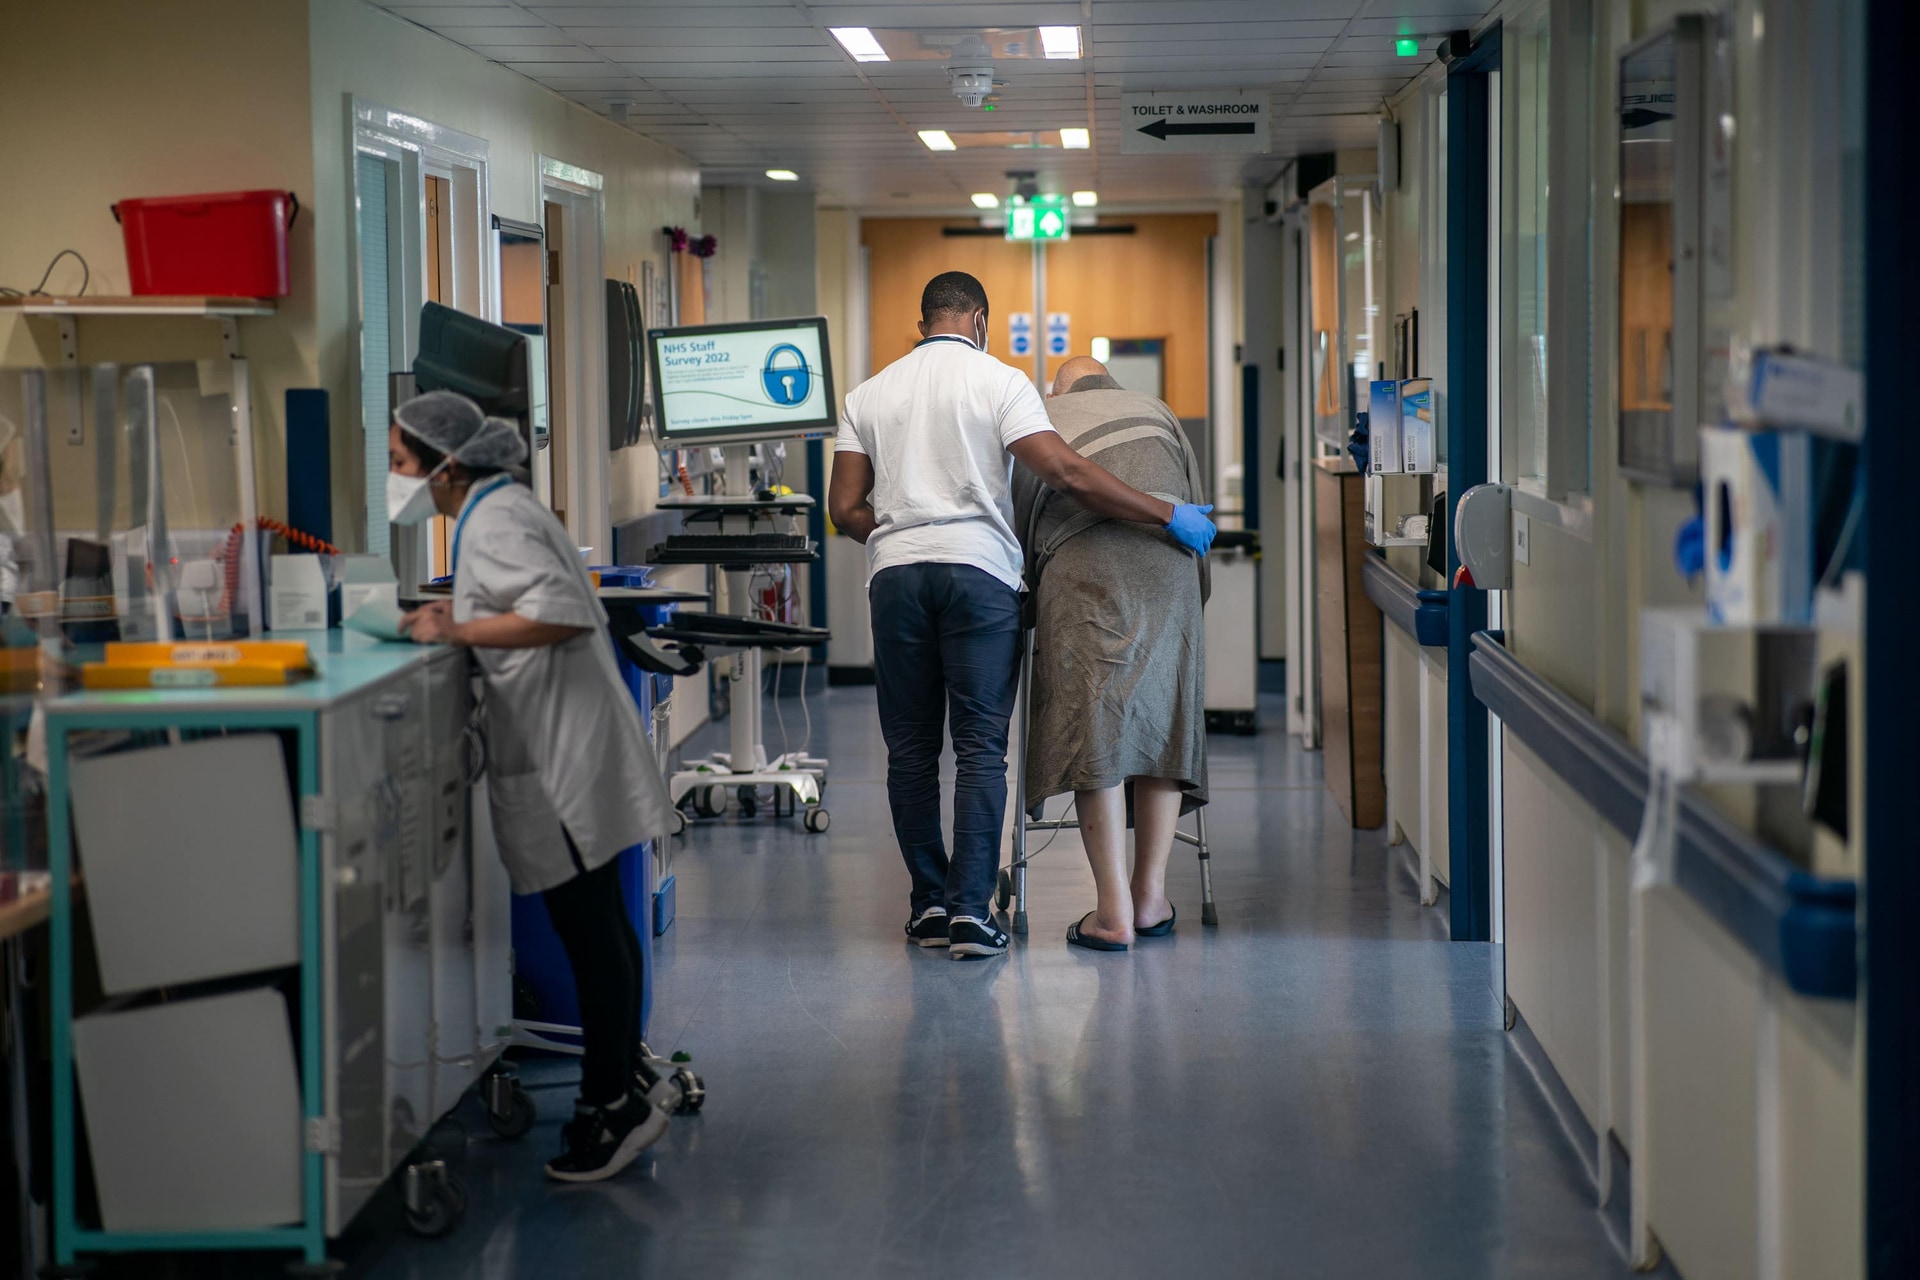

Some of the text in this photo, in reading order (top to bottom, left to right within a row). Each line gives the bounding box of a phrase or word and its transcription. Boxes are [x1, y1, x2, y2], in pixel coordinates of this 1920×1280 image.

[1132, 104, 1259, 115] TOILET & WASHROOM
[664, 341, 715, 353] NHS Staff
[665, 352, 730, 366] Survey 2022
[1383, 384, 1394, 392] L
[1416, 395, 1428, 403] L
